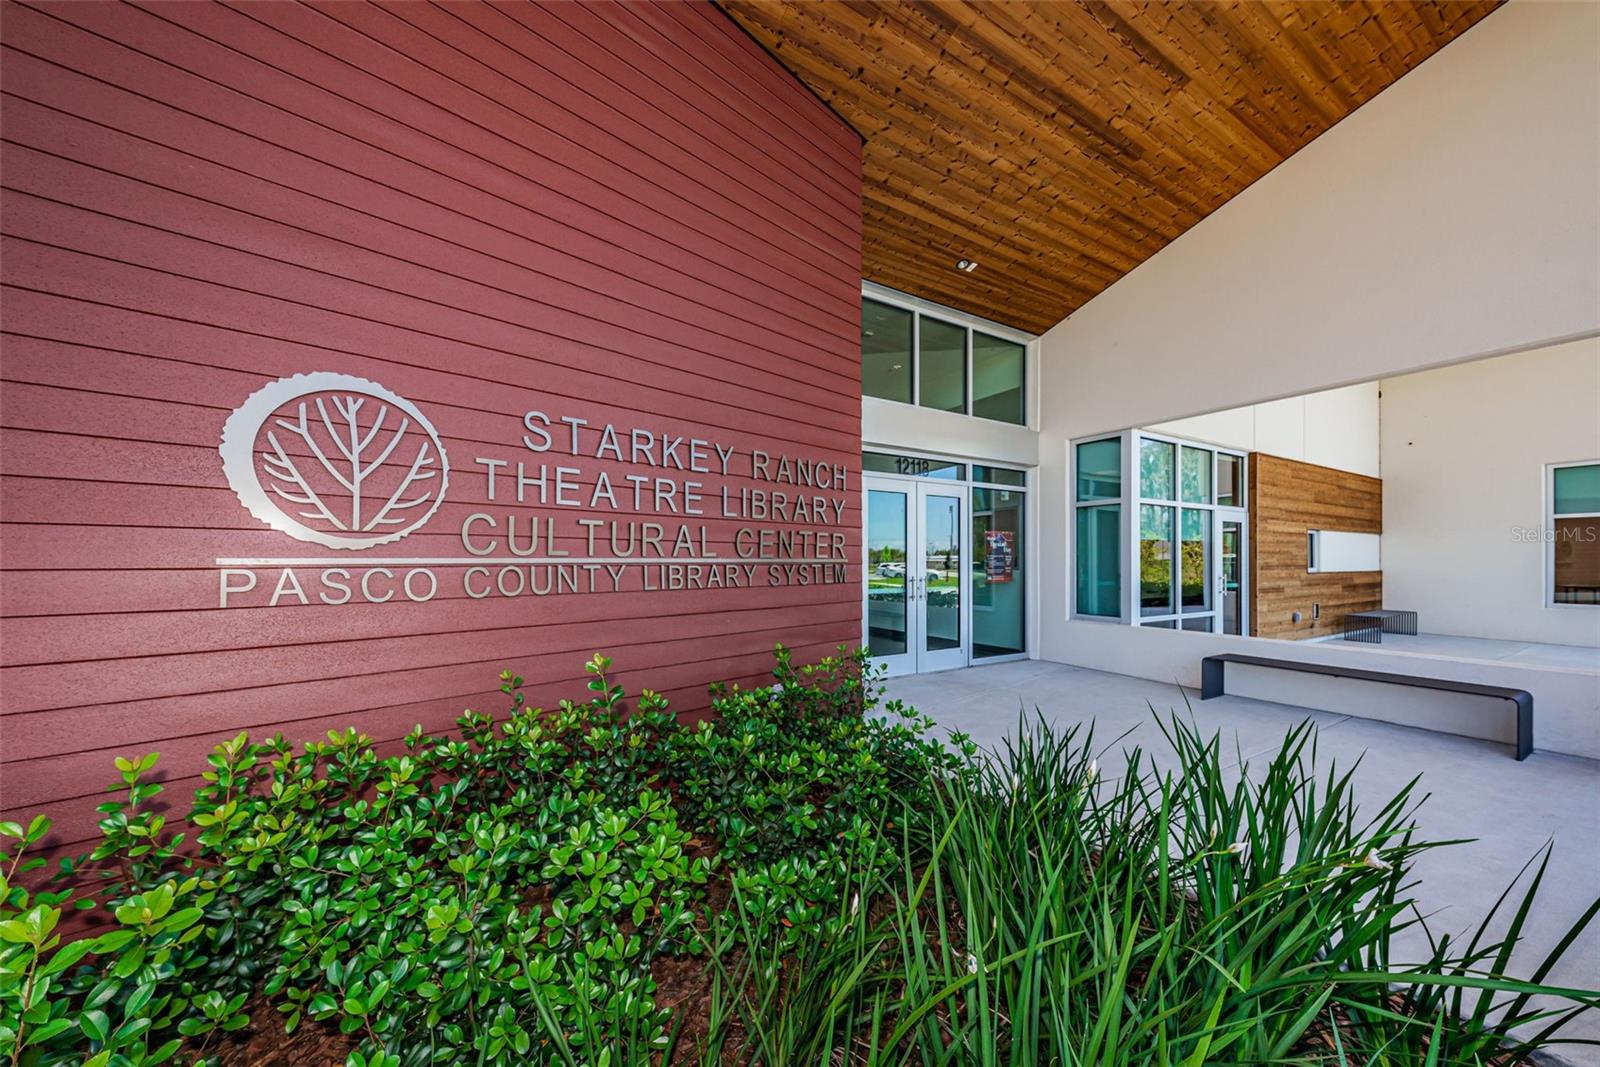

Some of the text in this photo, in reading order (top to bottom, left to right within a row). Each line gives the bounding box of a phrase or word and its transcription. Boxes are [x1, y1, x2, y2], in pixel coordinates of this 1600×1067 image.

[523, 410, 848, 491] STARKEY RANCH
[896, 457, 929, 477] 12118
[475, 457, 847, 525] THEATRE LIBRARY
[461, 513, 847, 559] CULTURAL CENTER
[220, 563, 848, 609] PASCO COUNTY LIBRARY SYSTEM
